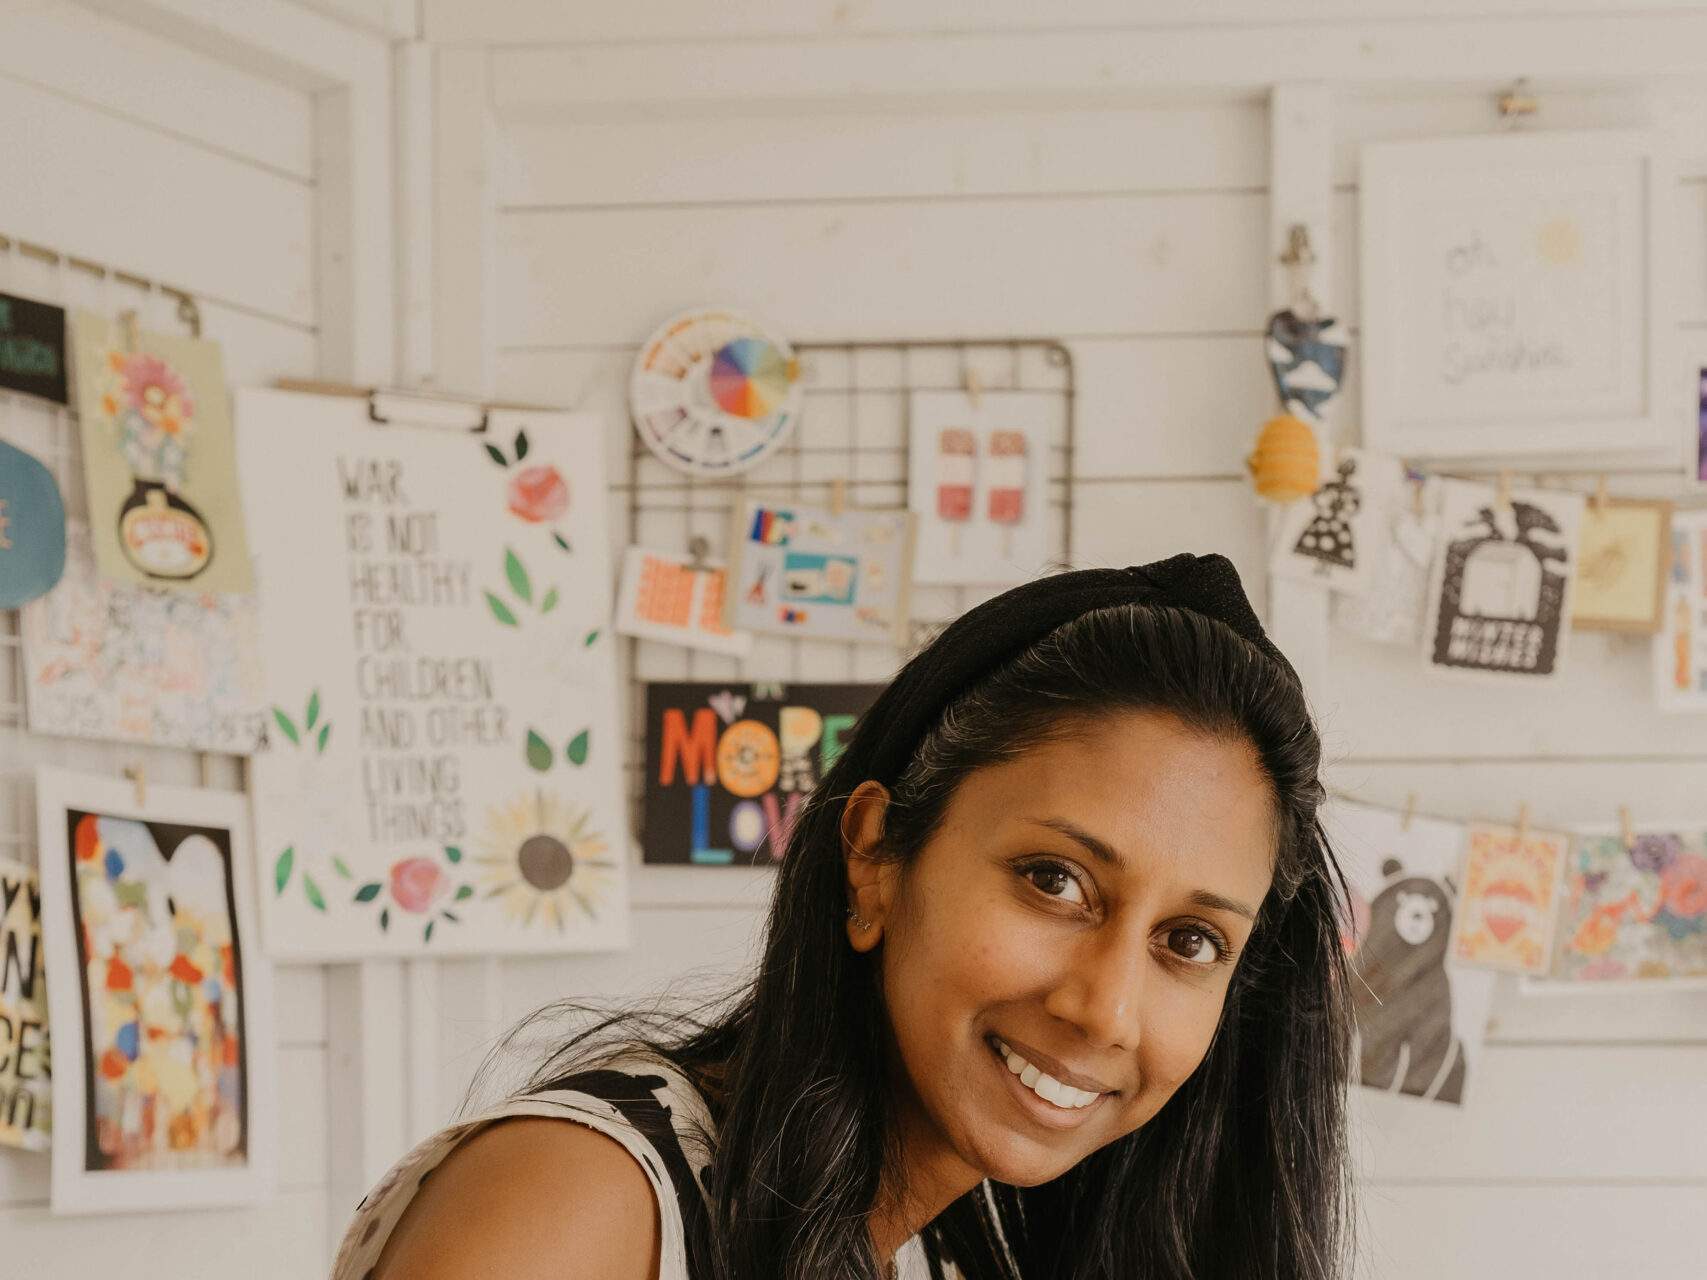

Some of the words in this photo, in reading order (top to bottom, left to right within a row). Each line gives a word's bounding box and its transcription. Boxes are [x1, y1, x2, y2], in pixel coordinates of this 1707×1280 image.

[336, 455, 410, 503] WAR
[347, 512, 373, 552] IS
[388, 510, 440, 557] NOT
[350, 559, 471, 607] HEALTHY
[353, 608, 411, 654] FOR
[355, 655, 495, 702] CHILDREN
[359, 706, 417, 749] AND
[425, 703, 513, 746] OTHER
[362, 753, 461, 797] LIVING
[363, 796, 468, 846] THINGS
